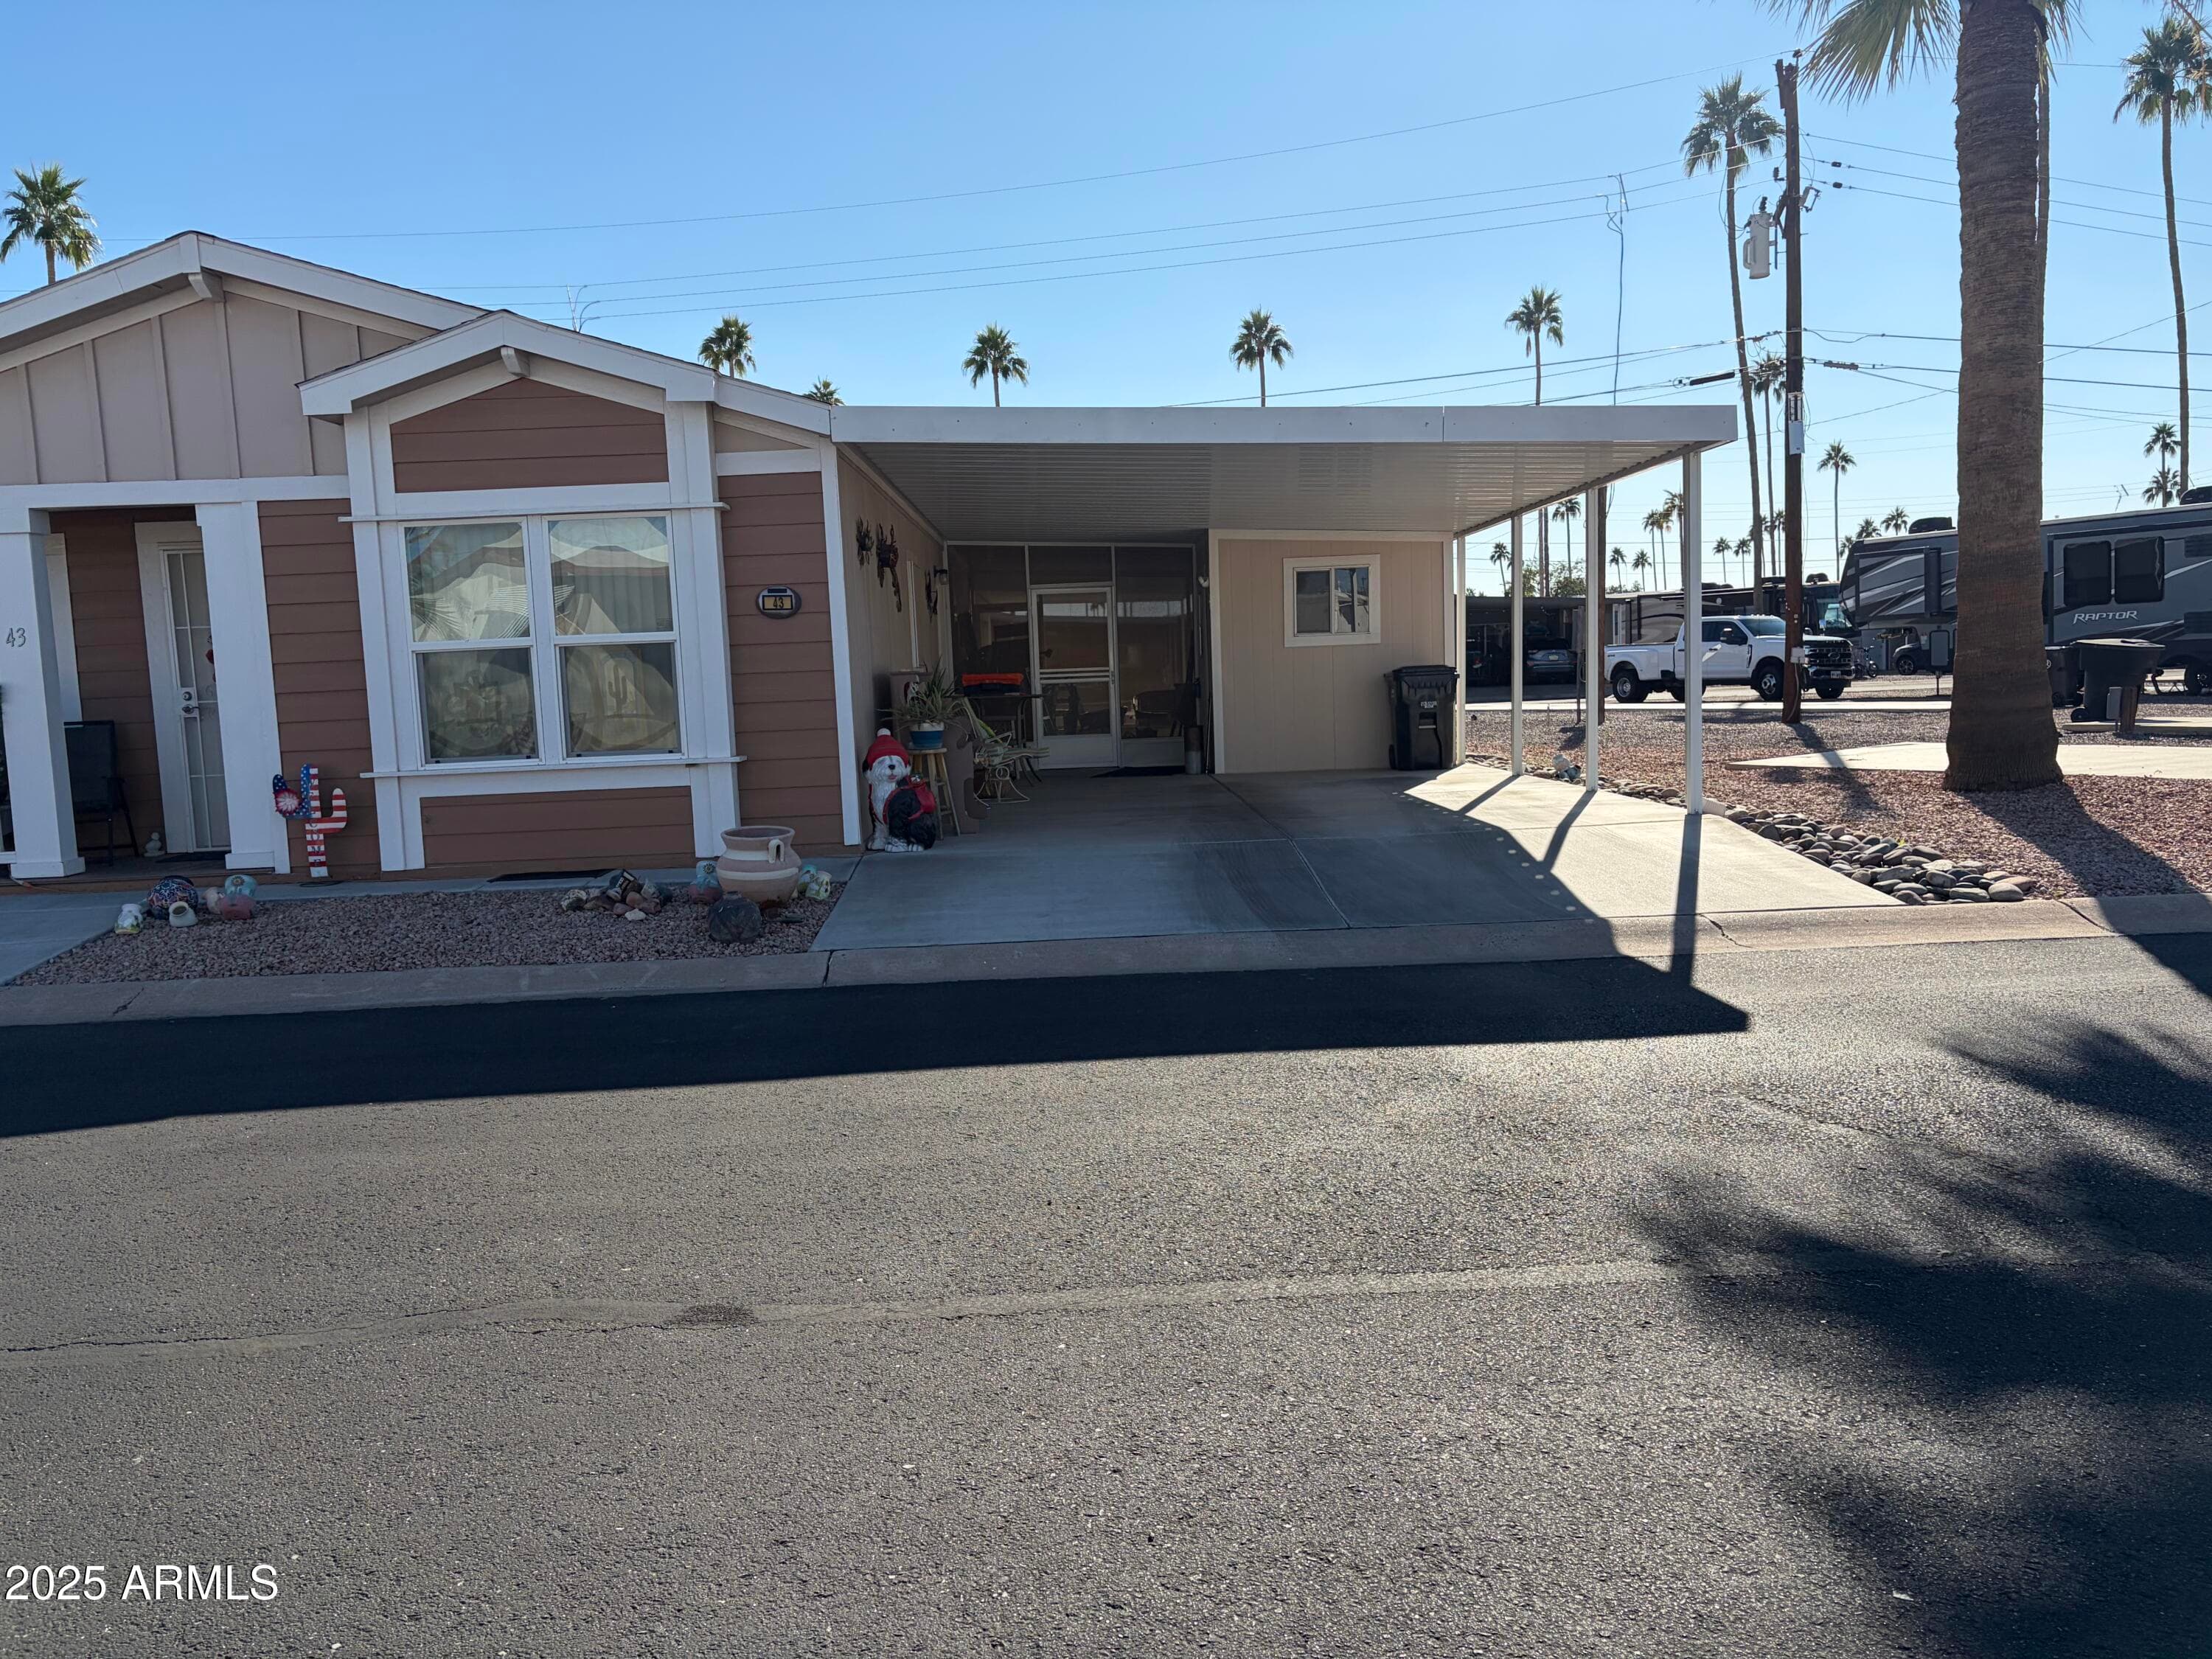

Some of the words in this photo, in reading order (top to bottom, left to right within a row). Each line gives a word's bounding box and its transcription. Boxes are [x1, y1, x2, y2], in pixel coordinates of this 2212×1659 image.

[773, 597, 784, 608] 43
[2073, 611, 2139, 625] RAPTOR
[6, 627, 26, 647] 43
